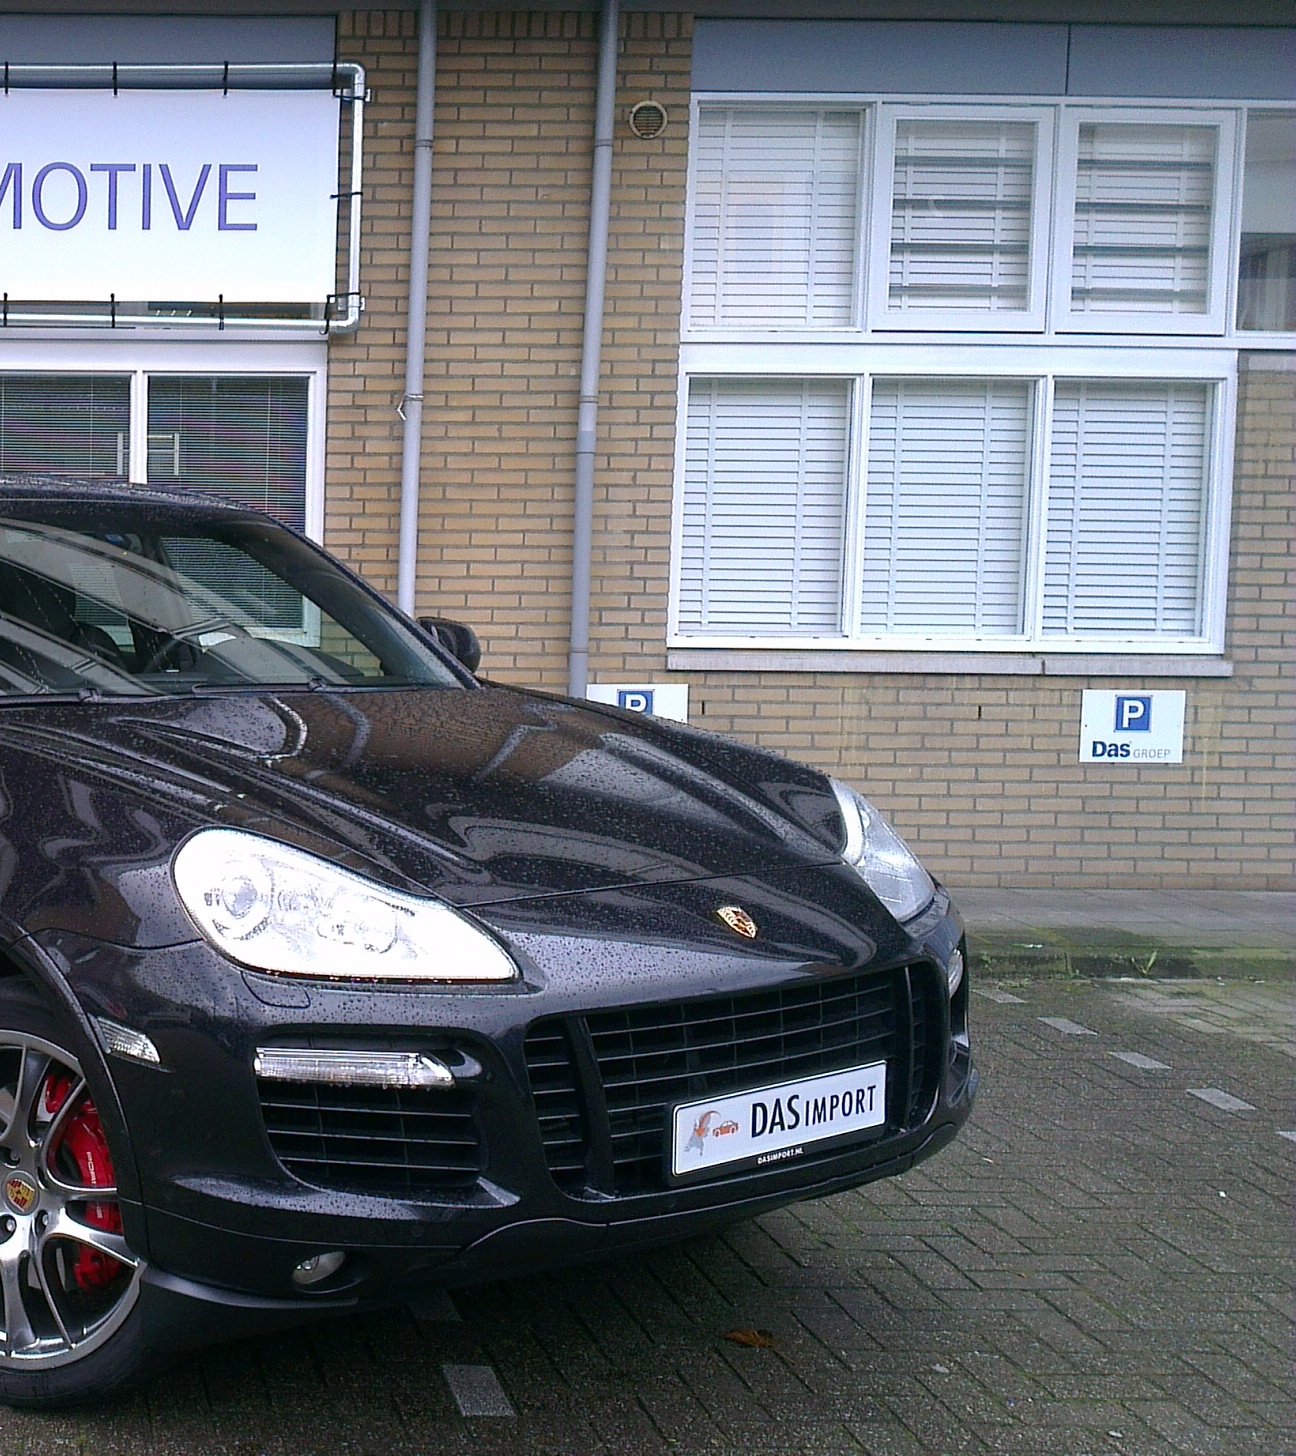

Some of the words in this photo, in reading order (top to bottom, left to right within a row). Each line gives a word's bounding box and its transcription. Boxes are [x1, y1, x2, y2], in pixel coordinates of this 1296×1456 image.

[1122, 699, 1145, 728] P
[1092, 740, 1131, 758] Das
[1133, 749, 1171, 758] GROEP
[751, 1094, 800, 1138] DAS
[805, 1085, 876, 1127] IMPORT
